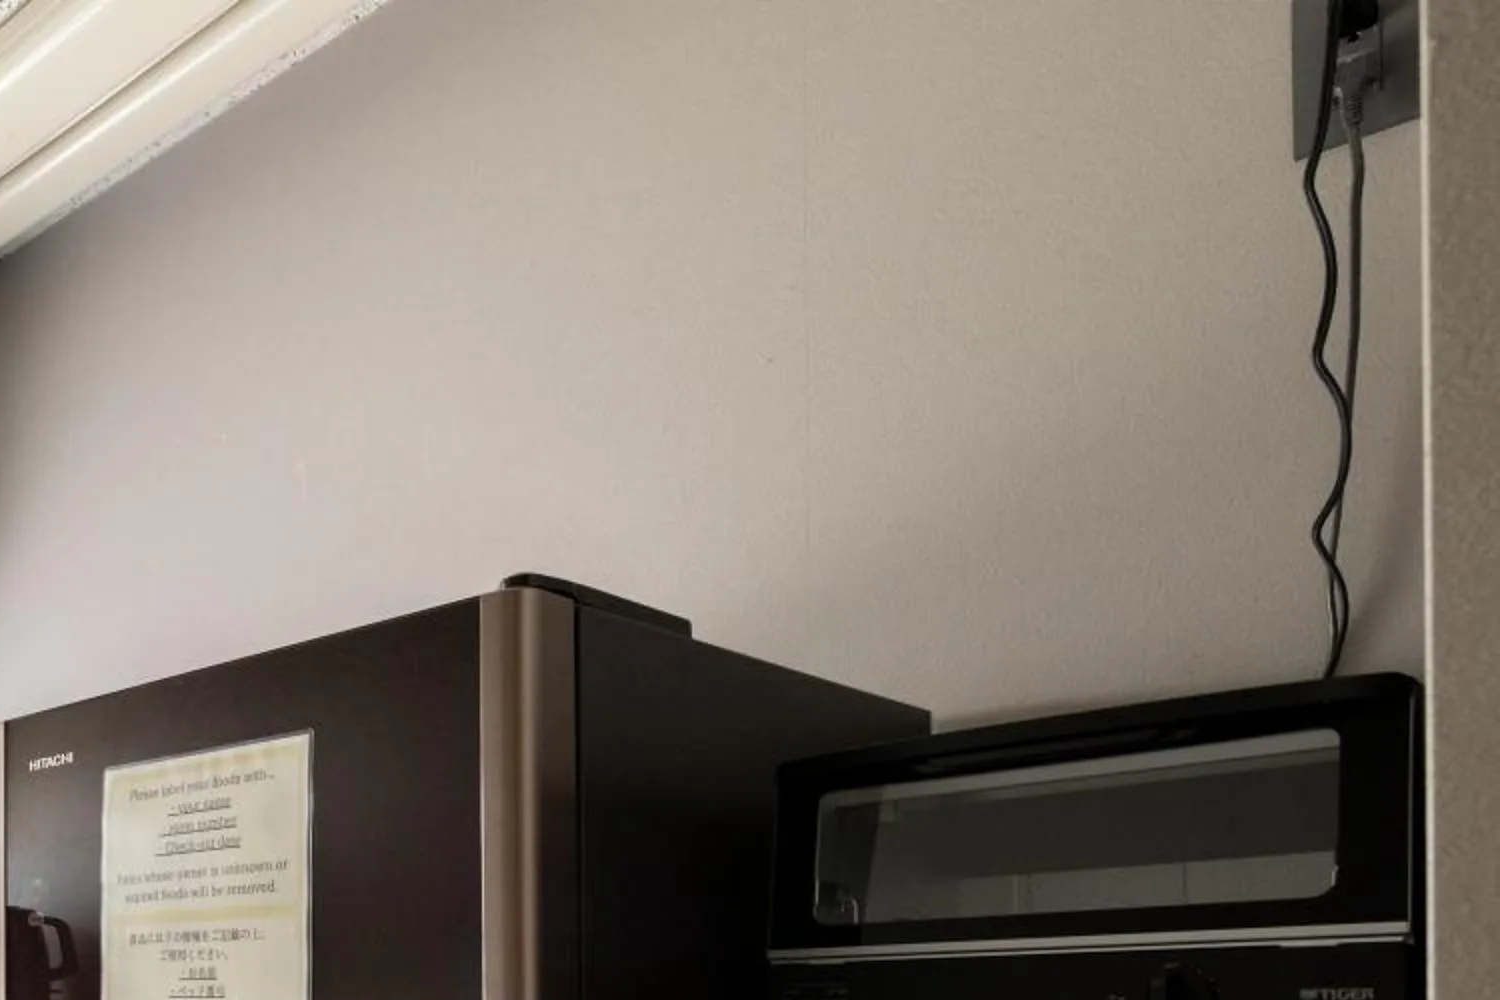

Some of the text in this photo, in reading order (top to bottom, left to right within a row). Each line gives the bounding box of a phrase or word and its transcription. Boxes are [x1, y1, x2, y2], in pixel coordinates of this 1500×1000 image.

[29, 751, 73, 772] HITACHI
[130, 788, 159, 801] Please
[212, 884, 223, 897] be
[1320, 987, 1375, 1000] TIGER
